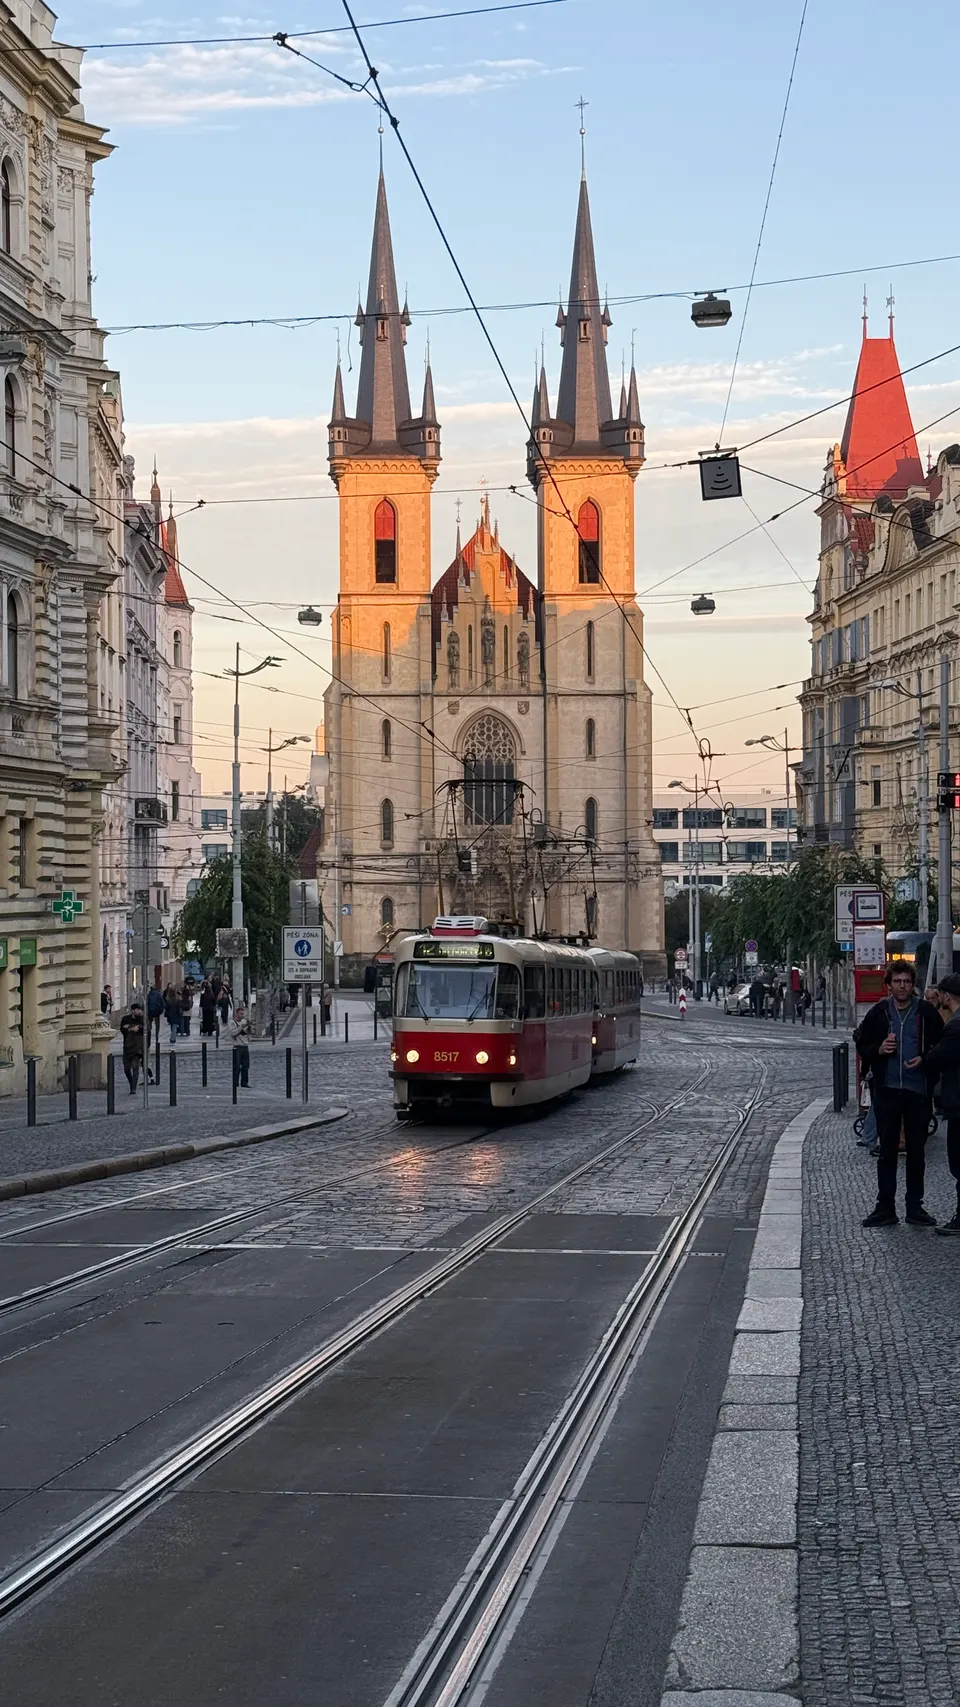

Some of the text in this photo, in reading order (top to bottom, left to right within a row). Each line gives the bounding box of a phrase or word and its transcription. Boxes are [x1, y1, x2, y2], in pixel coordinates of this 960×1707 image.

[939, 775, 945, 785] P
[938, 795, 945, 805] L
[434, 1051, 460, 1062] 8517
